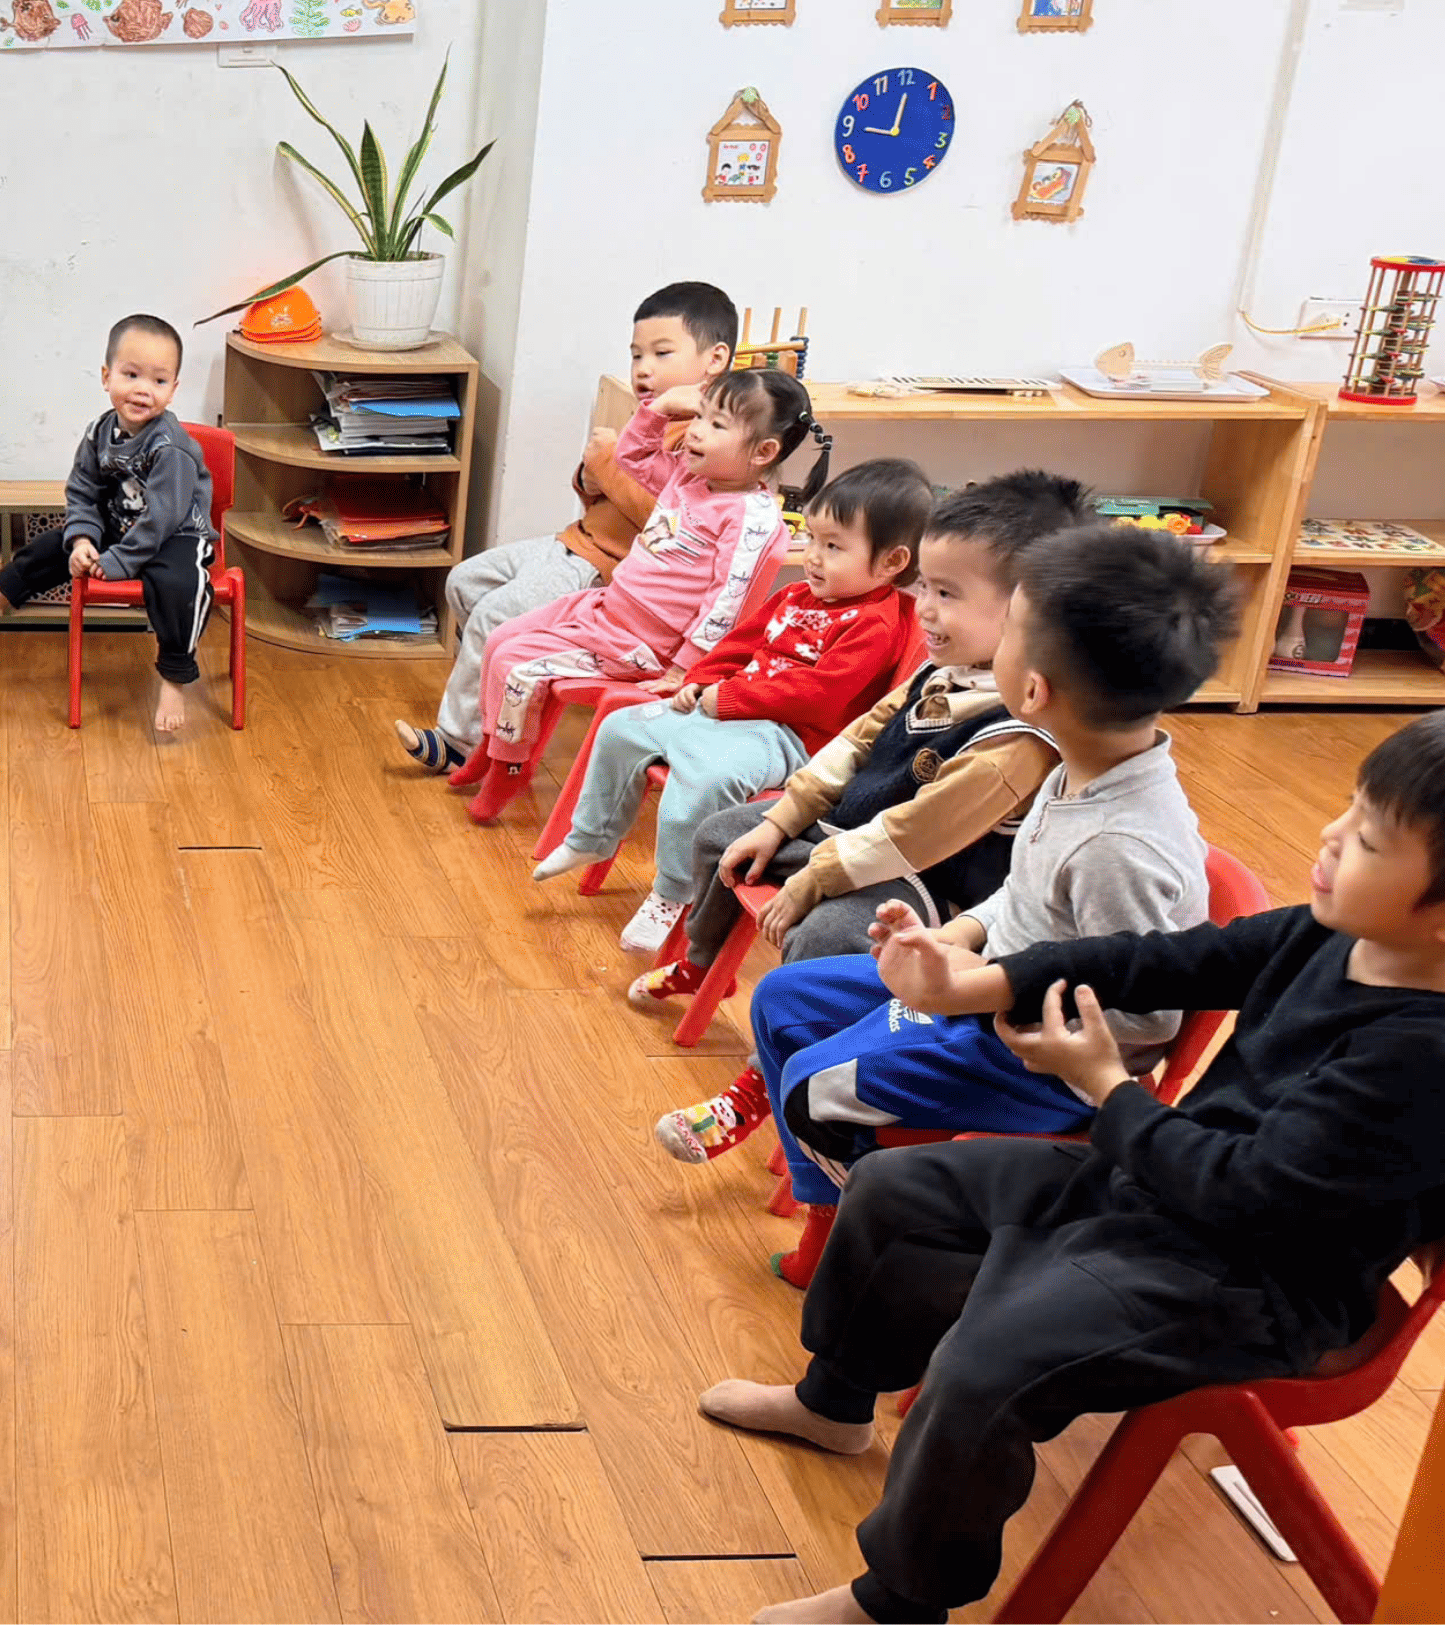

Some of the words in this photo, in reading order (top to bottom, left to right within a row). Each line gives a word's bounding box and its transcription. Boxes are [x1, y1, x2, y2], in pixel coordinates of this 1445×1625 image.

[873, 75, 889, 96] 11
[897, 69, 916, 86] 12
[927, 81, 939, 101] 1
[852, 93, 870, 112] 10
[842, 115, 855, 137] 9
[934, 131, 948, 149] 3
[842, 144, 856, 163] 8
[923, 154, 936, 170] 4
[857, 163, 868, 184] 7
[879, 171, 892, 188] 6
[904, 167, 917, 187] 5
[888, 998, 903, 1033] adidas
